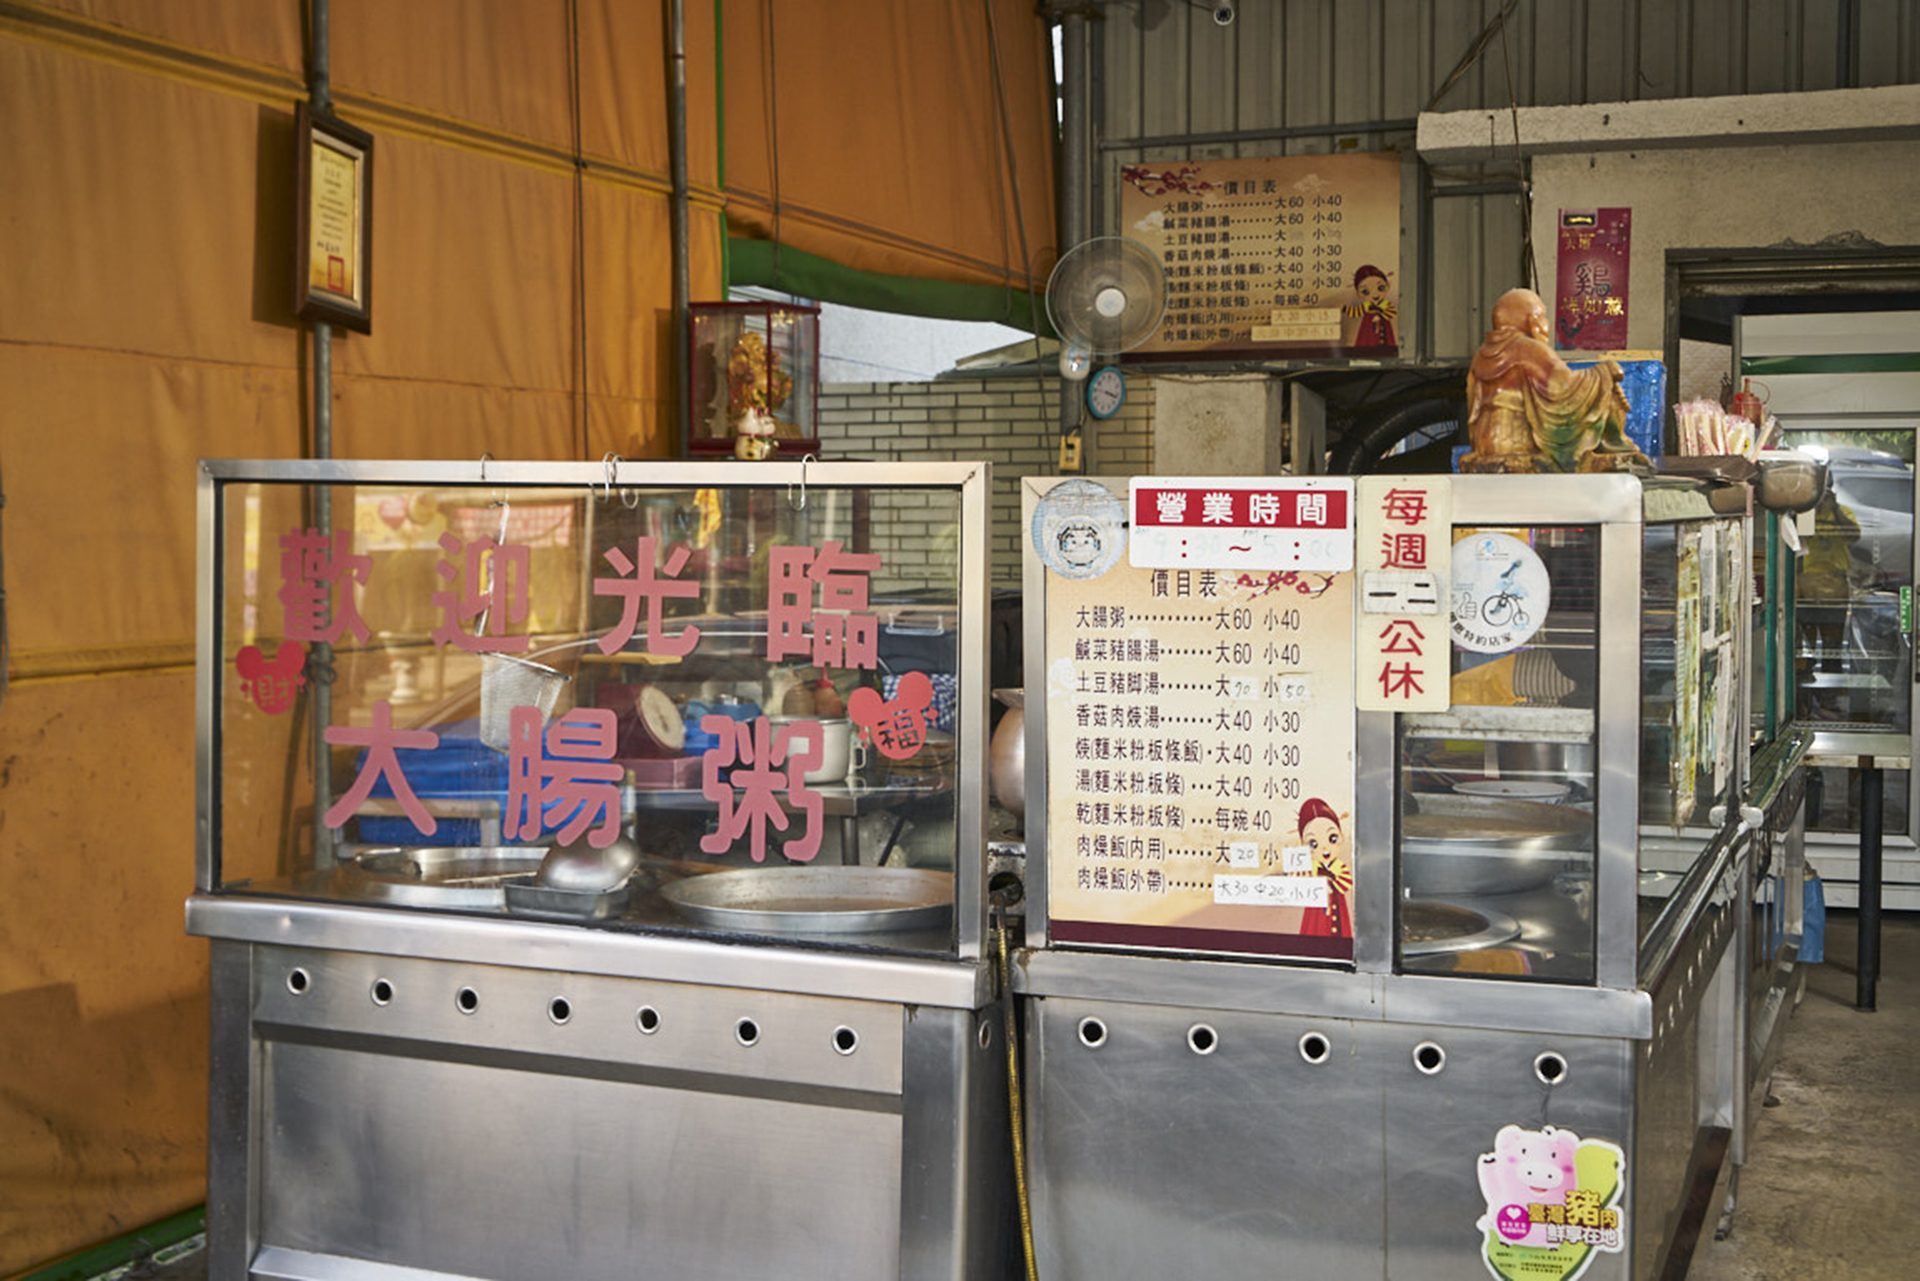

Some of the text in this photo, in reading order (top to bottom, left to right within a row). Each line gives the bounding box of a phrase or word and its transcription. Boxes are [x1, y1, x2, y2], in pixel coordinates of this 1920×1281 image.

[1156, 492, 1327, 525] 營業時間
[1151, 569, 1218, 598] 價目表
[278, 527, 882, 670] 歡迎光臨
[1076, 605, 1300, 631] 大腸粥 大60 小40
[1215, 641, 1252, 664] 大60
[1264, 642, 1300, 665] 小40
[877, 709, 920, 750] 福
[1215, 708, 1252, 731] 大40
[1264, 709, 1300, 733] 小30
[1215, 741, 1252, 766] 大40
[1264, 743, 1300, 767] 小30
[323, 700, 826, 863] 大腸粥
[1215, 774, 1252, 798] 大40
[1264, 776, 1300, 800] 小30
